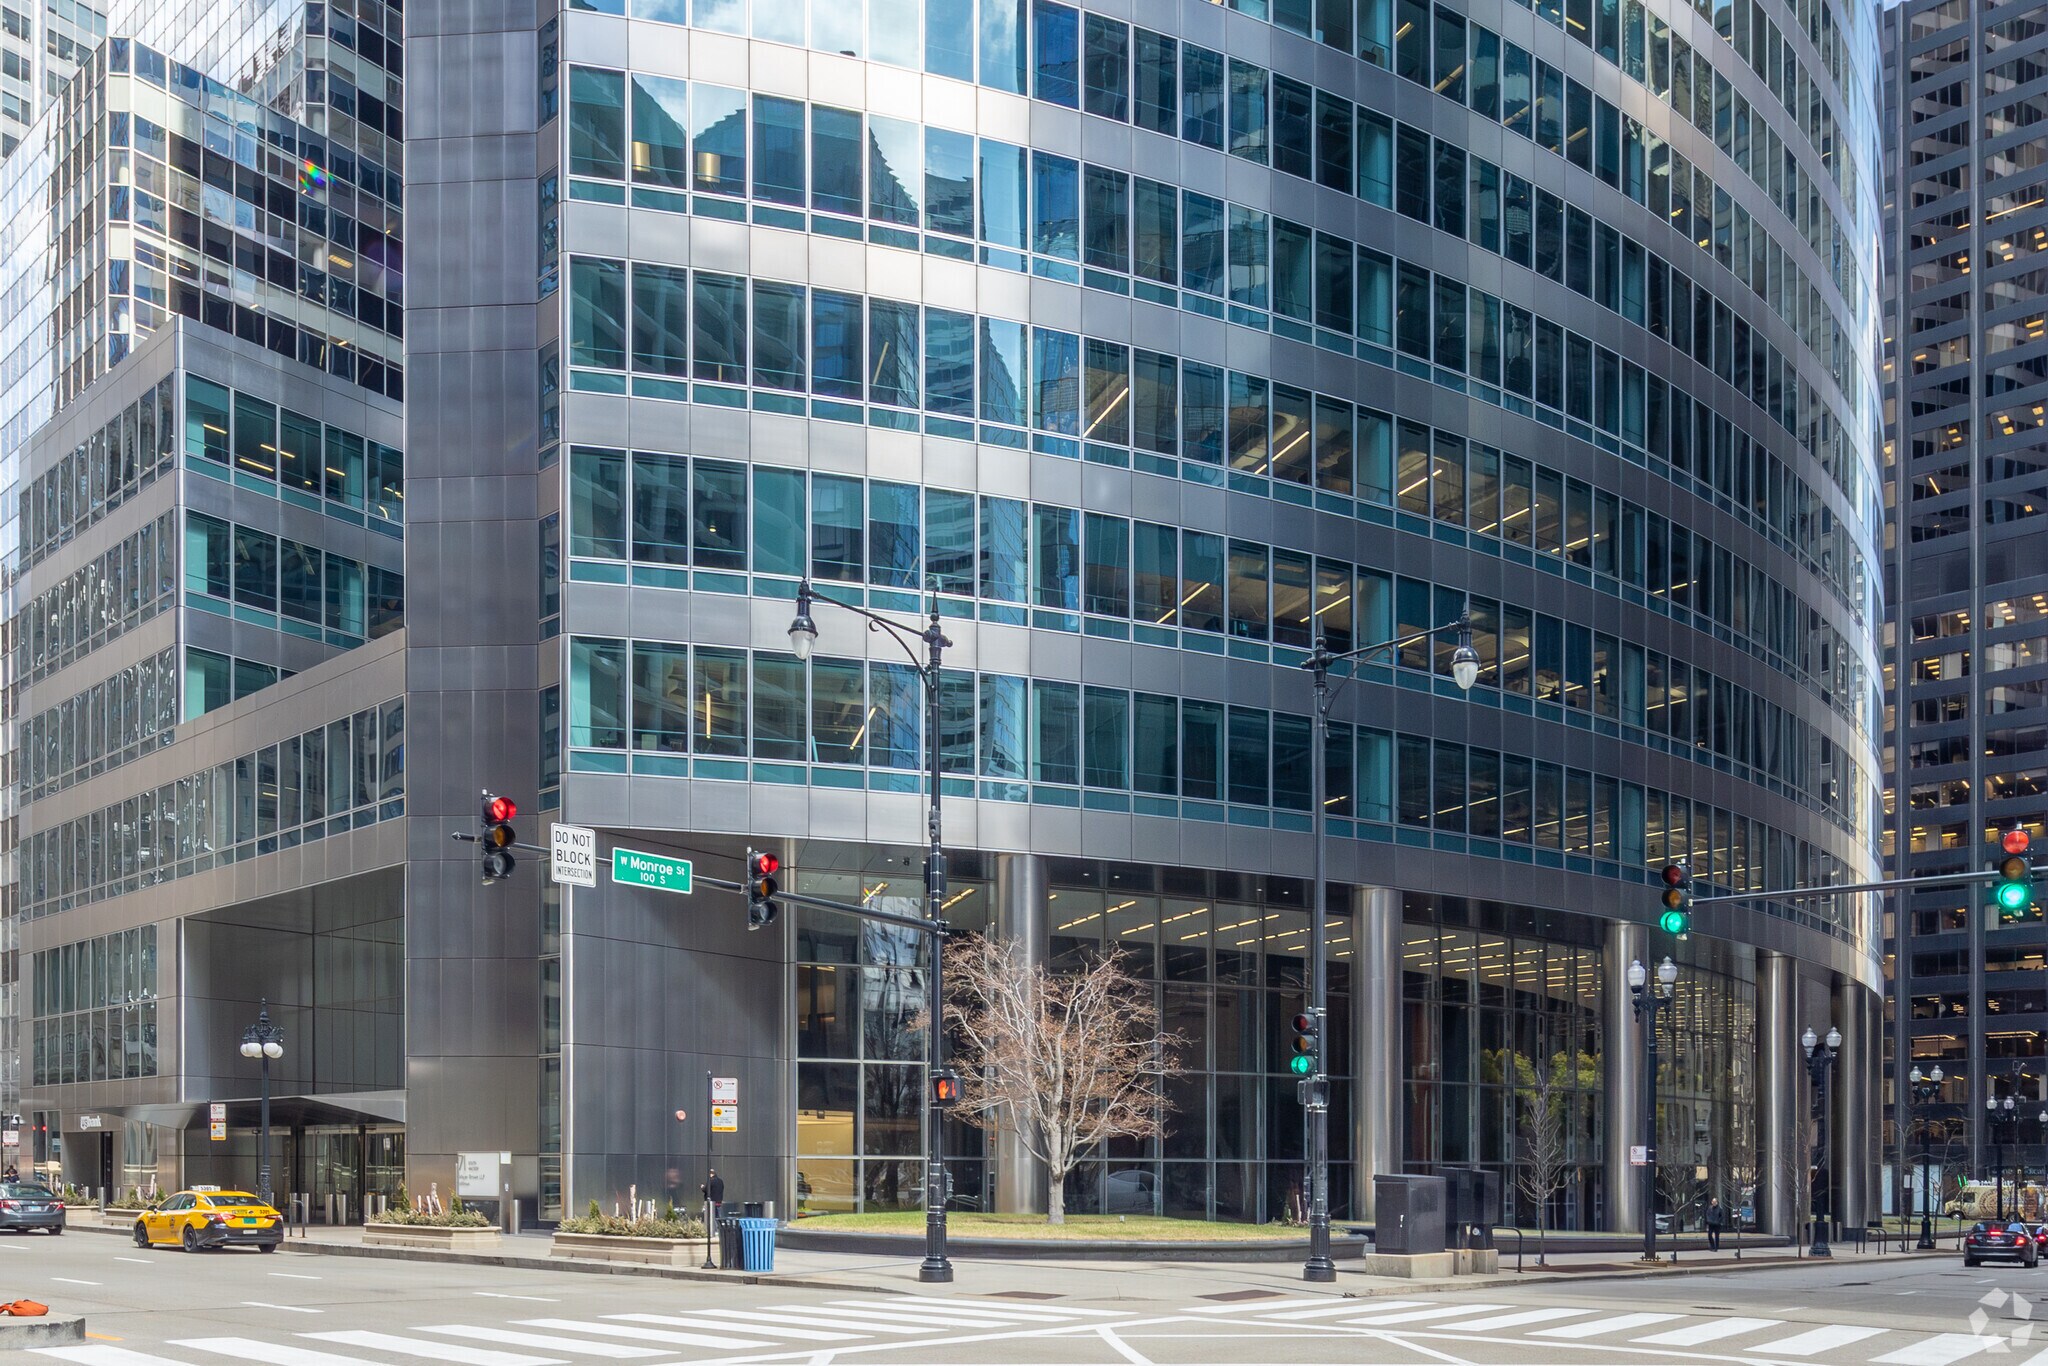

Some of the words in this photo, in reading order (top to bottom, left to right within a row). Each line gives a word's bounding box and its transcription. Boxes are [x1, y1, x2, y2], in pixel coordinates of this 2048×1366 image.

[556, 831, 568, 843] DO
[572, 834, 591, 847] NOT
[557, 849, 591, 865] BLOCK
[556, 866, 592, 879] INTERSECTION
[630, 856, 673, 875] Monroe
[676, 866, 685, 876] St
[640, 872, 655, 883] 100
[660, 875, 666, 885] S
